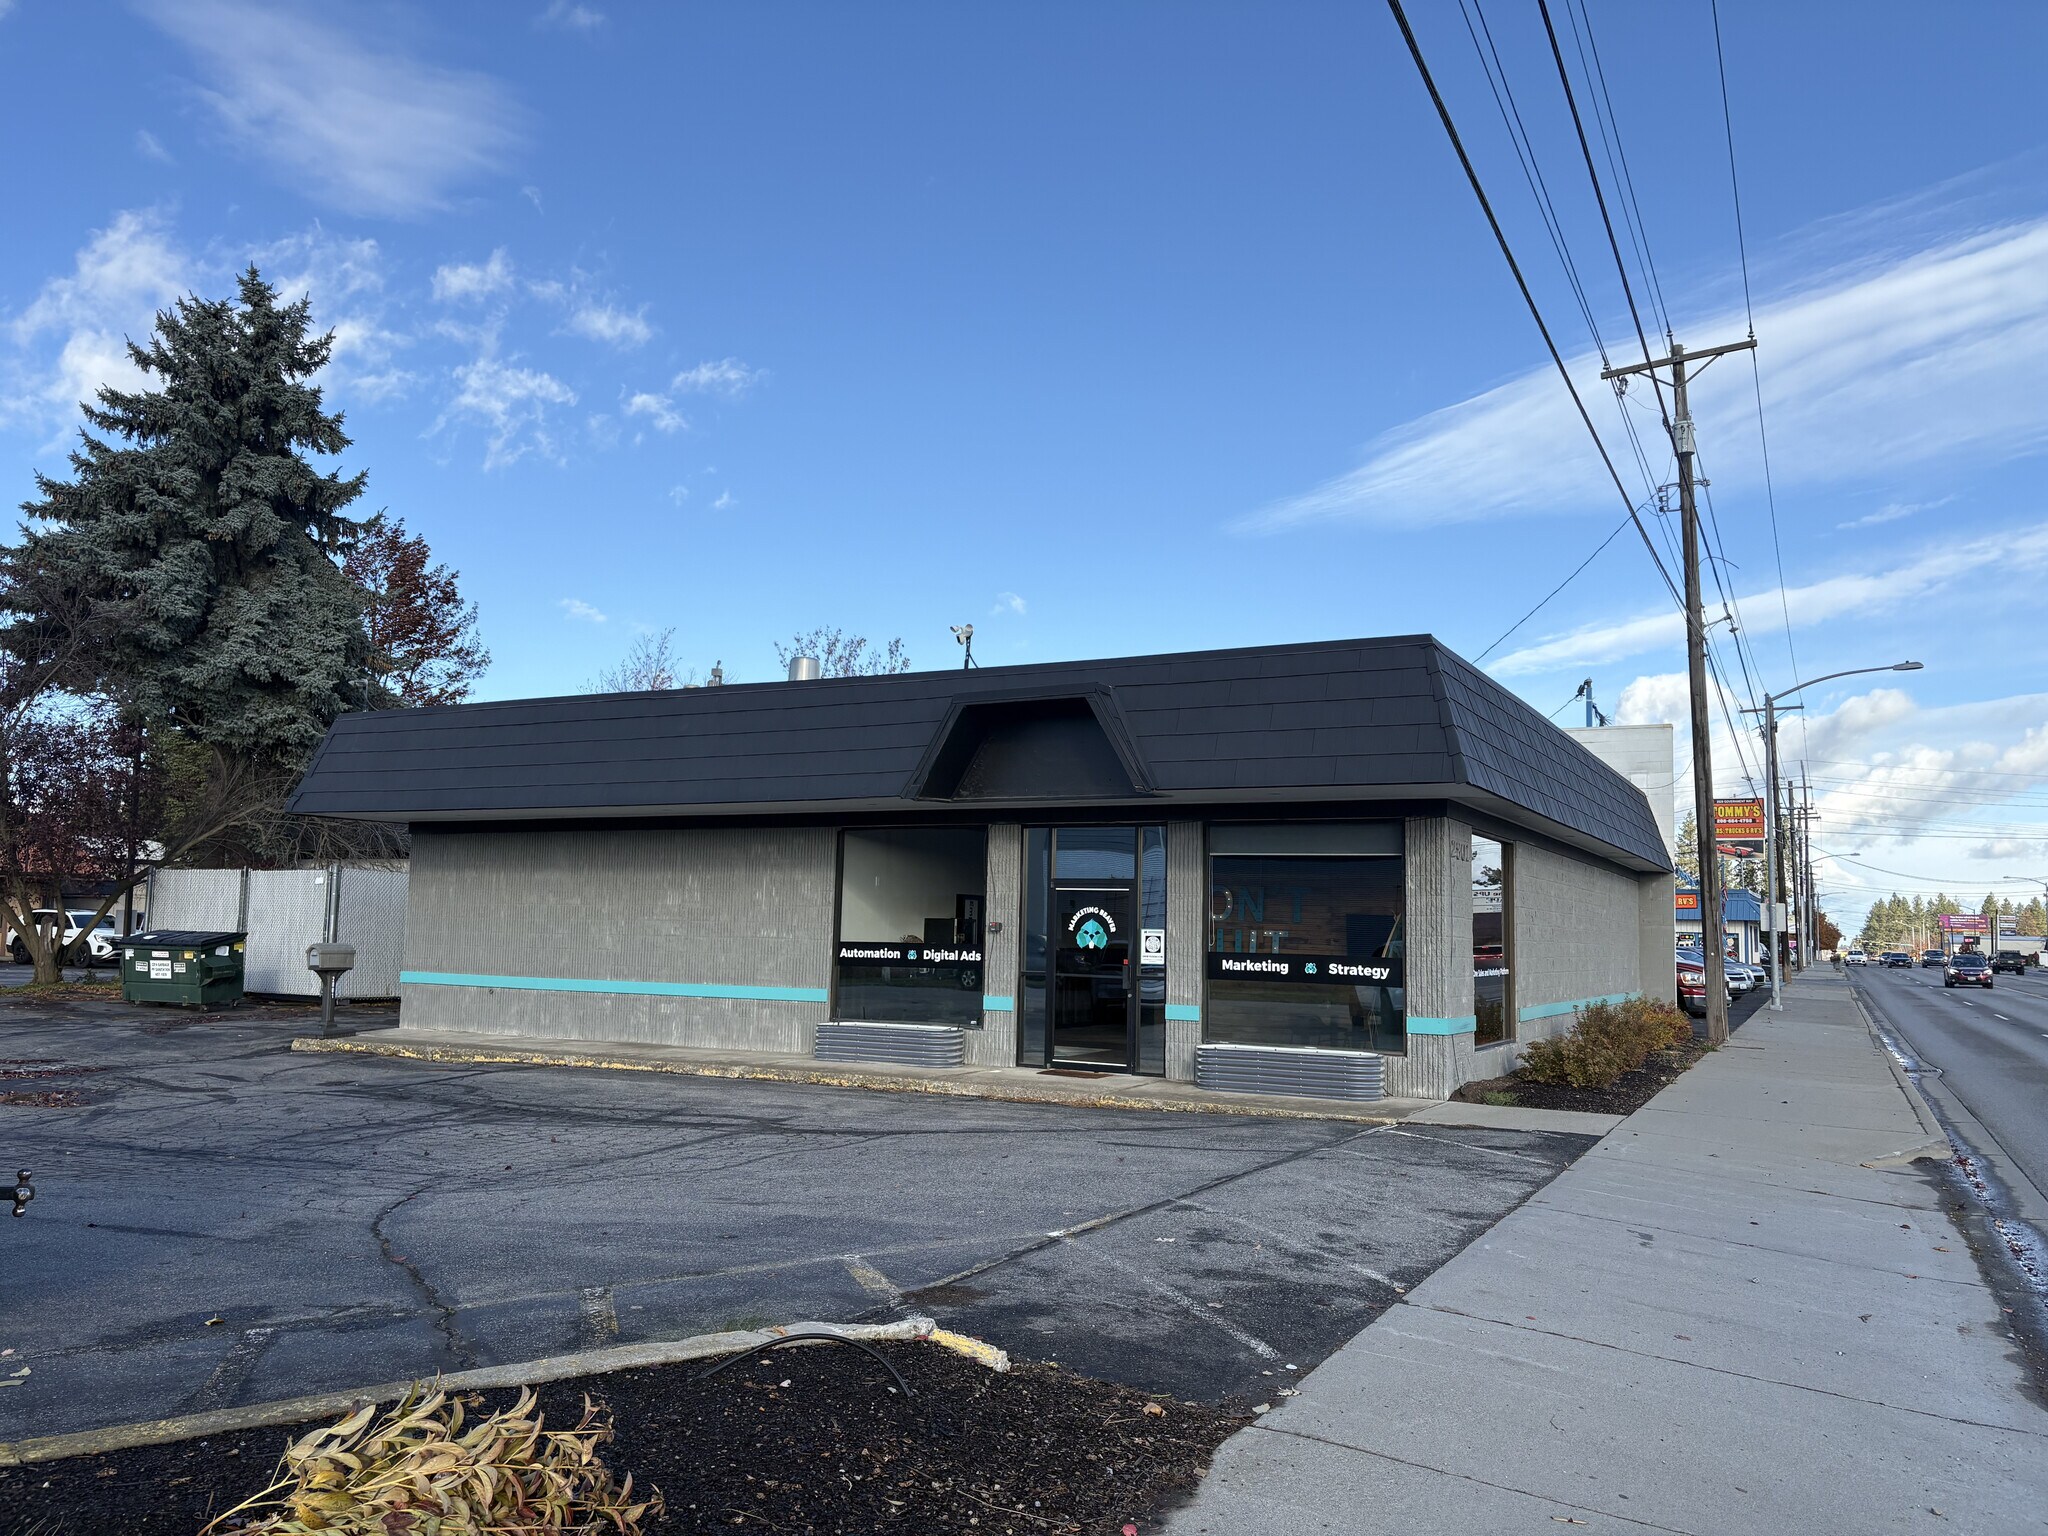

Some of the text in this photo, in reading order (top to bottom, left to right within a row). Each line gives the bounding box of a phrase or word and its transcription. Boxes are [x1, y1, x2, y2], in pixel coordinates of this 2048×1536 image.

[1713, 805, 1761, 817] TOMMY'S
[1677, 897, 1694, 905] RV'S
[1067, 906, 1117, 933] MARKETING BEAVER
[839, 948, 982, 963] Automation Digital Ads
[1221, 959, 1391, 980] Marketing Strategy
